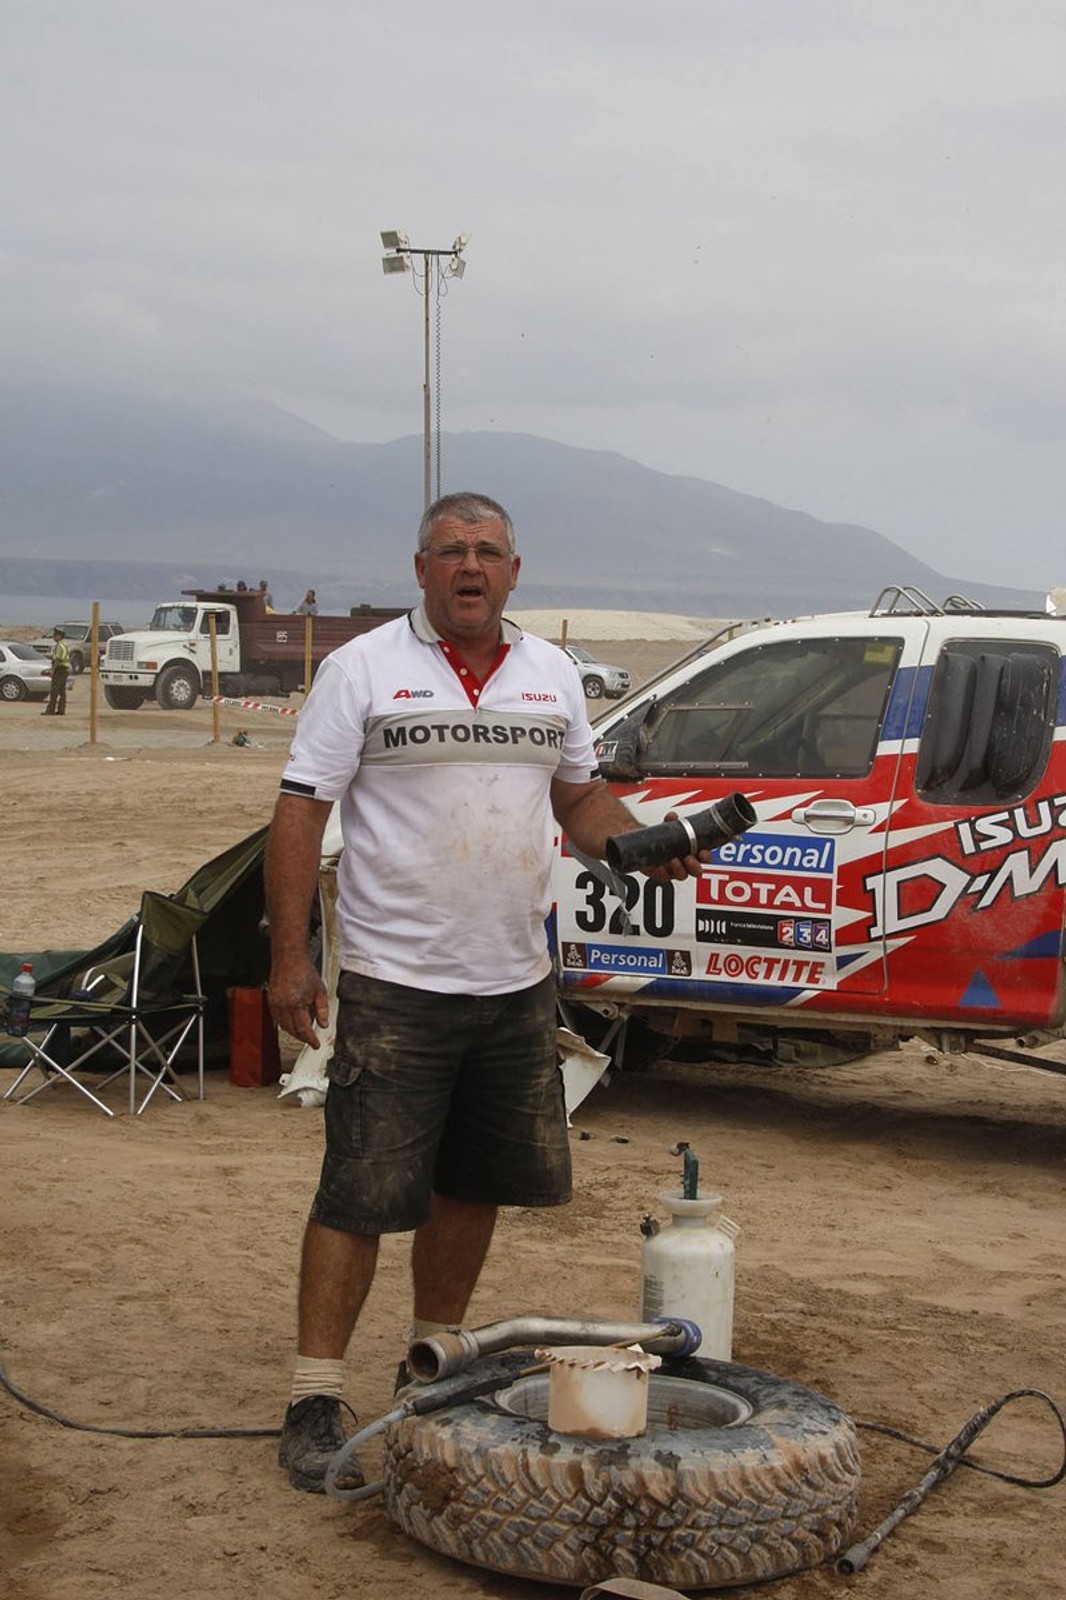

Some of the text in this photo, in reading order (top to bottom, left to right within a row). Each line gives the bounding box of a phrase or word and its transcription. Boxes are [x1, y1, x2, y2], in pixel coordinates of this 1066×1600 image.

[522, 693, 557, 703] ISUZU
[383, 724, 565, 751] MOTORSPORT
[711, 840, 831, 869] ersonal
[575, 871, 675, 938] 320
[702, 873, 827, 910] TOTAL
[782, 927, 829, 945] 2 3 4
[590, 949, 663, 968] Personal
[705, 952, 826, 985] LOCTITE
